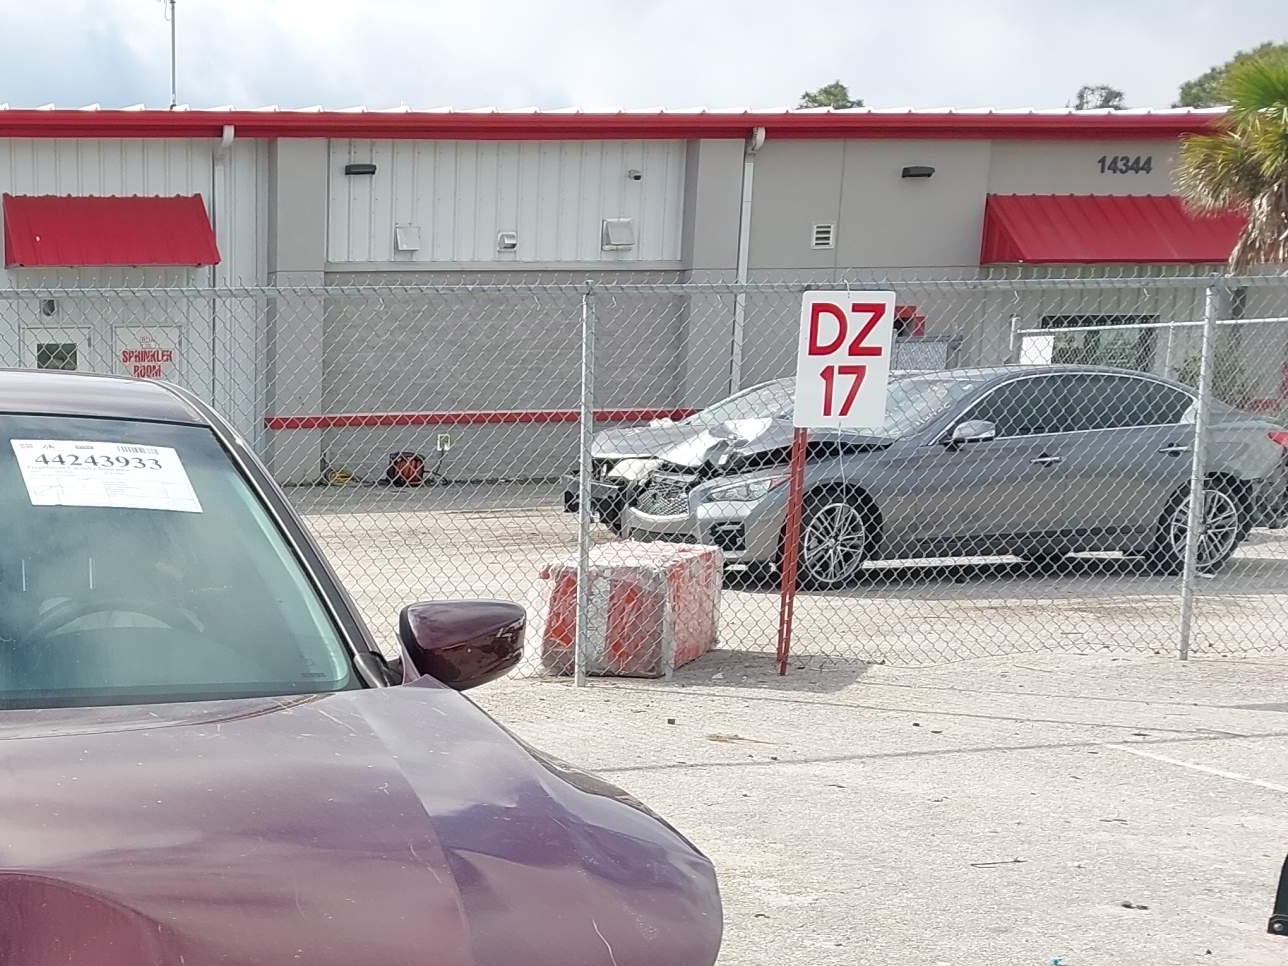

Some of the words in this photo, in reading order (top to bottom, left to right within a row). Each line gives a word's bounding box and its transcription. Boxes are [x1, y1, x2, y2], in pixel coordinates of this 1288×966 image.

[1097, 155, 1153, 174] 14344
[808, 303, 887, 356] DZ
[122, 350, 173, 363] SPRINKLER
[133, 365, 161, 377] ROOM
[819, 365, 867, 416] 17
[34, 453, 163, 470] 44243933
